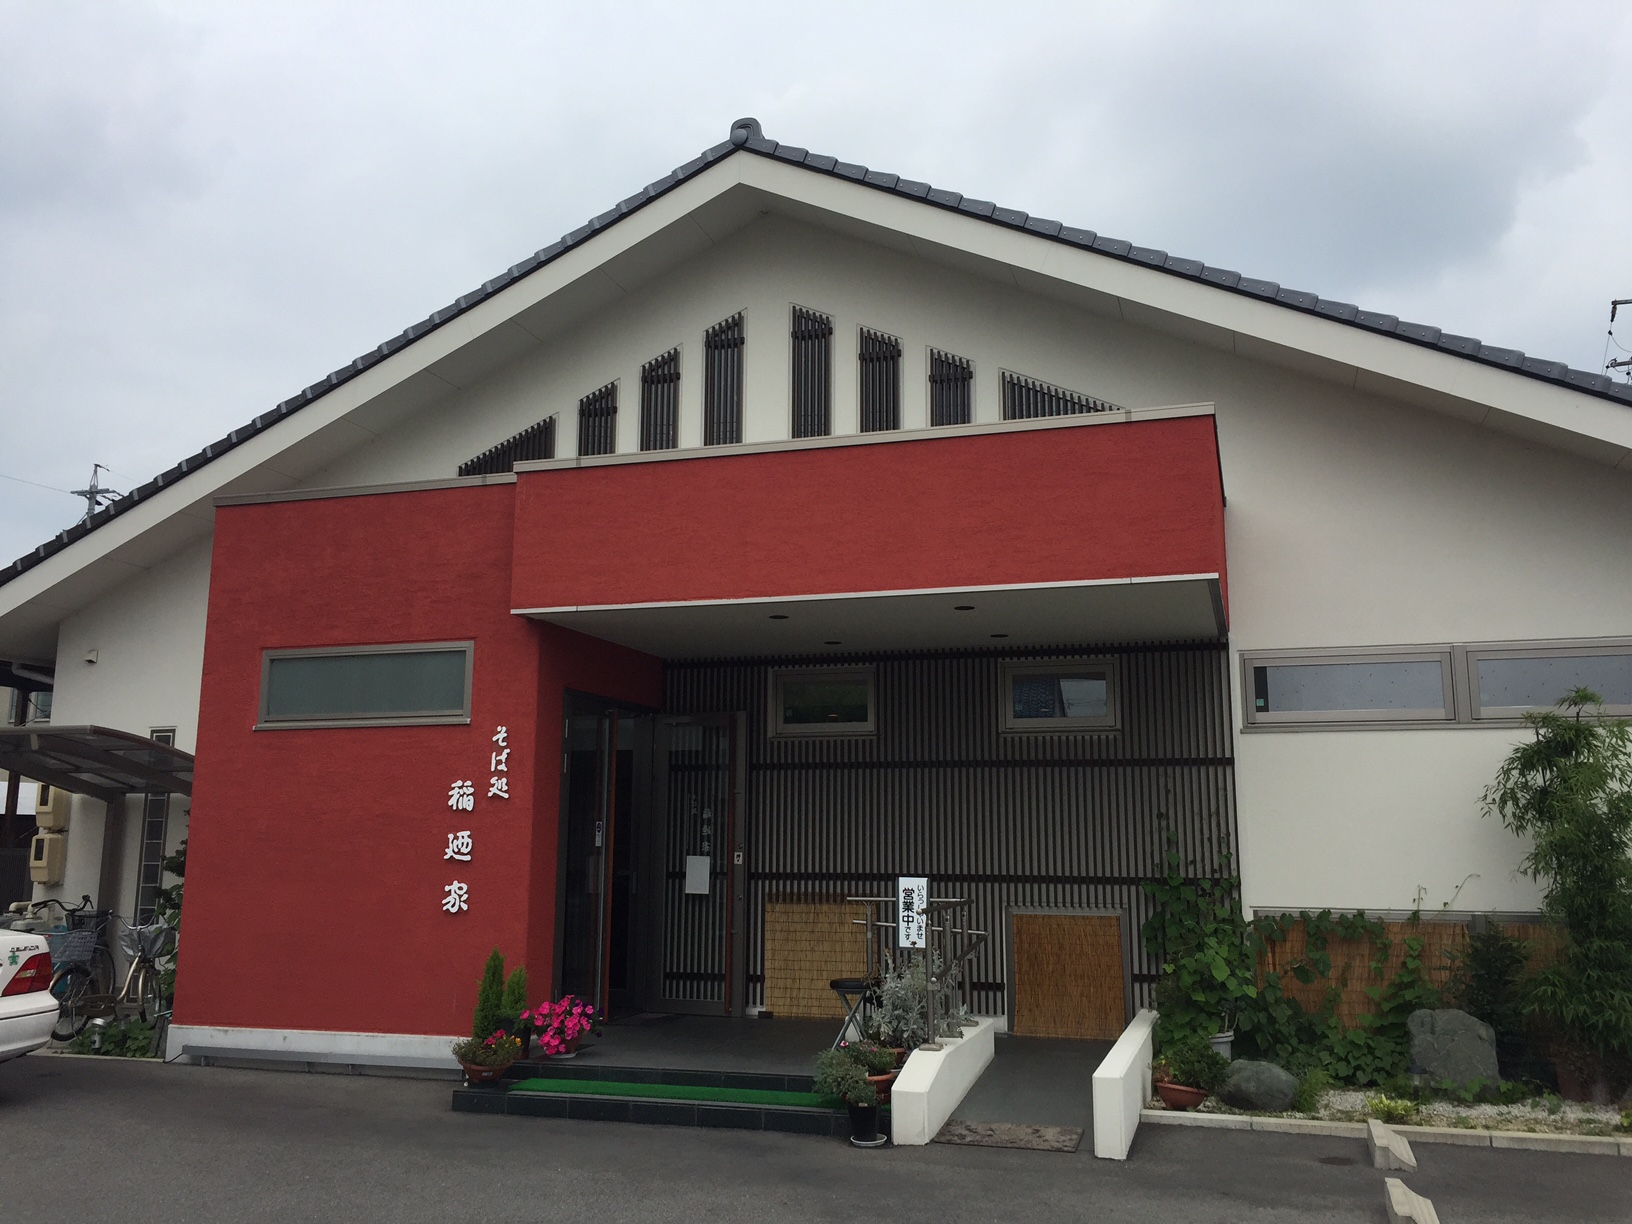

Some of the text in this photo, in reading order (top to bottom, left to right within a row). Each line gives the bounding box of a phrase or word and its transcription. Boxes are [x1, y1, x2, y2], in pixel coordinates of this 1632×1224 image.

[488, 725, 511, 799] そば処
[916, 884, 925, 940] いらっいませ
